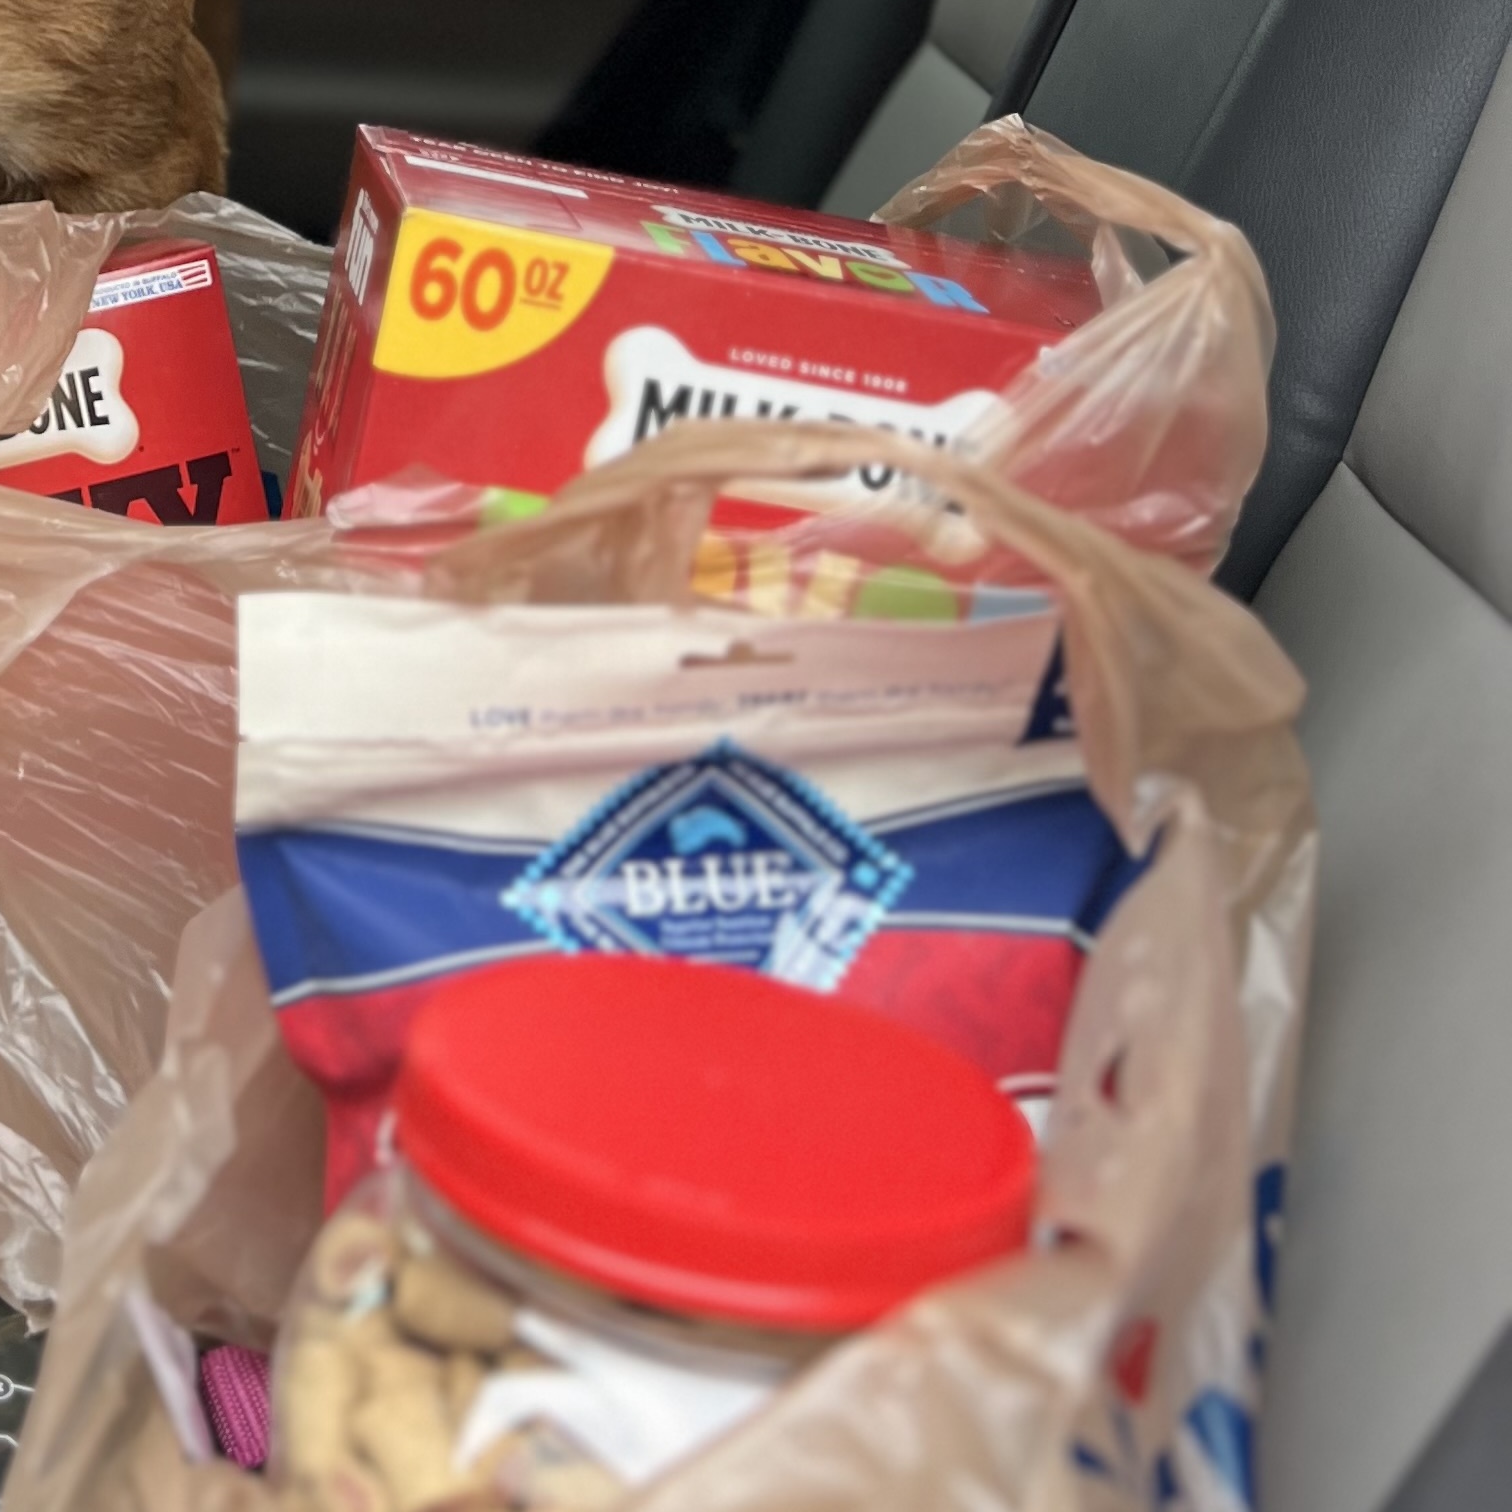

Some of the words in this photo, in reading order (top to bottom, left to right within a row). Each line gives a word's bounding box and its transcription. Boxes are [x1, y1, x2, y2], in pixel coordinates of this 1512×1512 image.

[677, 211, 891, 262] MILK-BONE
[92, 293, 120, 308] NEW
[159, 279, 184, 293] USA
[409, 235, 517, 333] 60
[729, 346, 793, 373] LOVED
[798, 356, 857, 384] SINCE
[862, 367, 908, 394] 1908
[619, 848, 798, 919] BLUE
